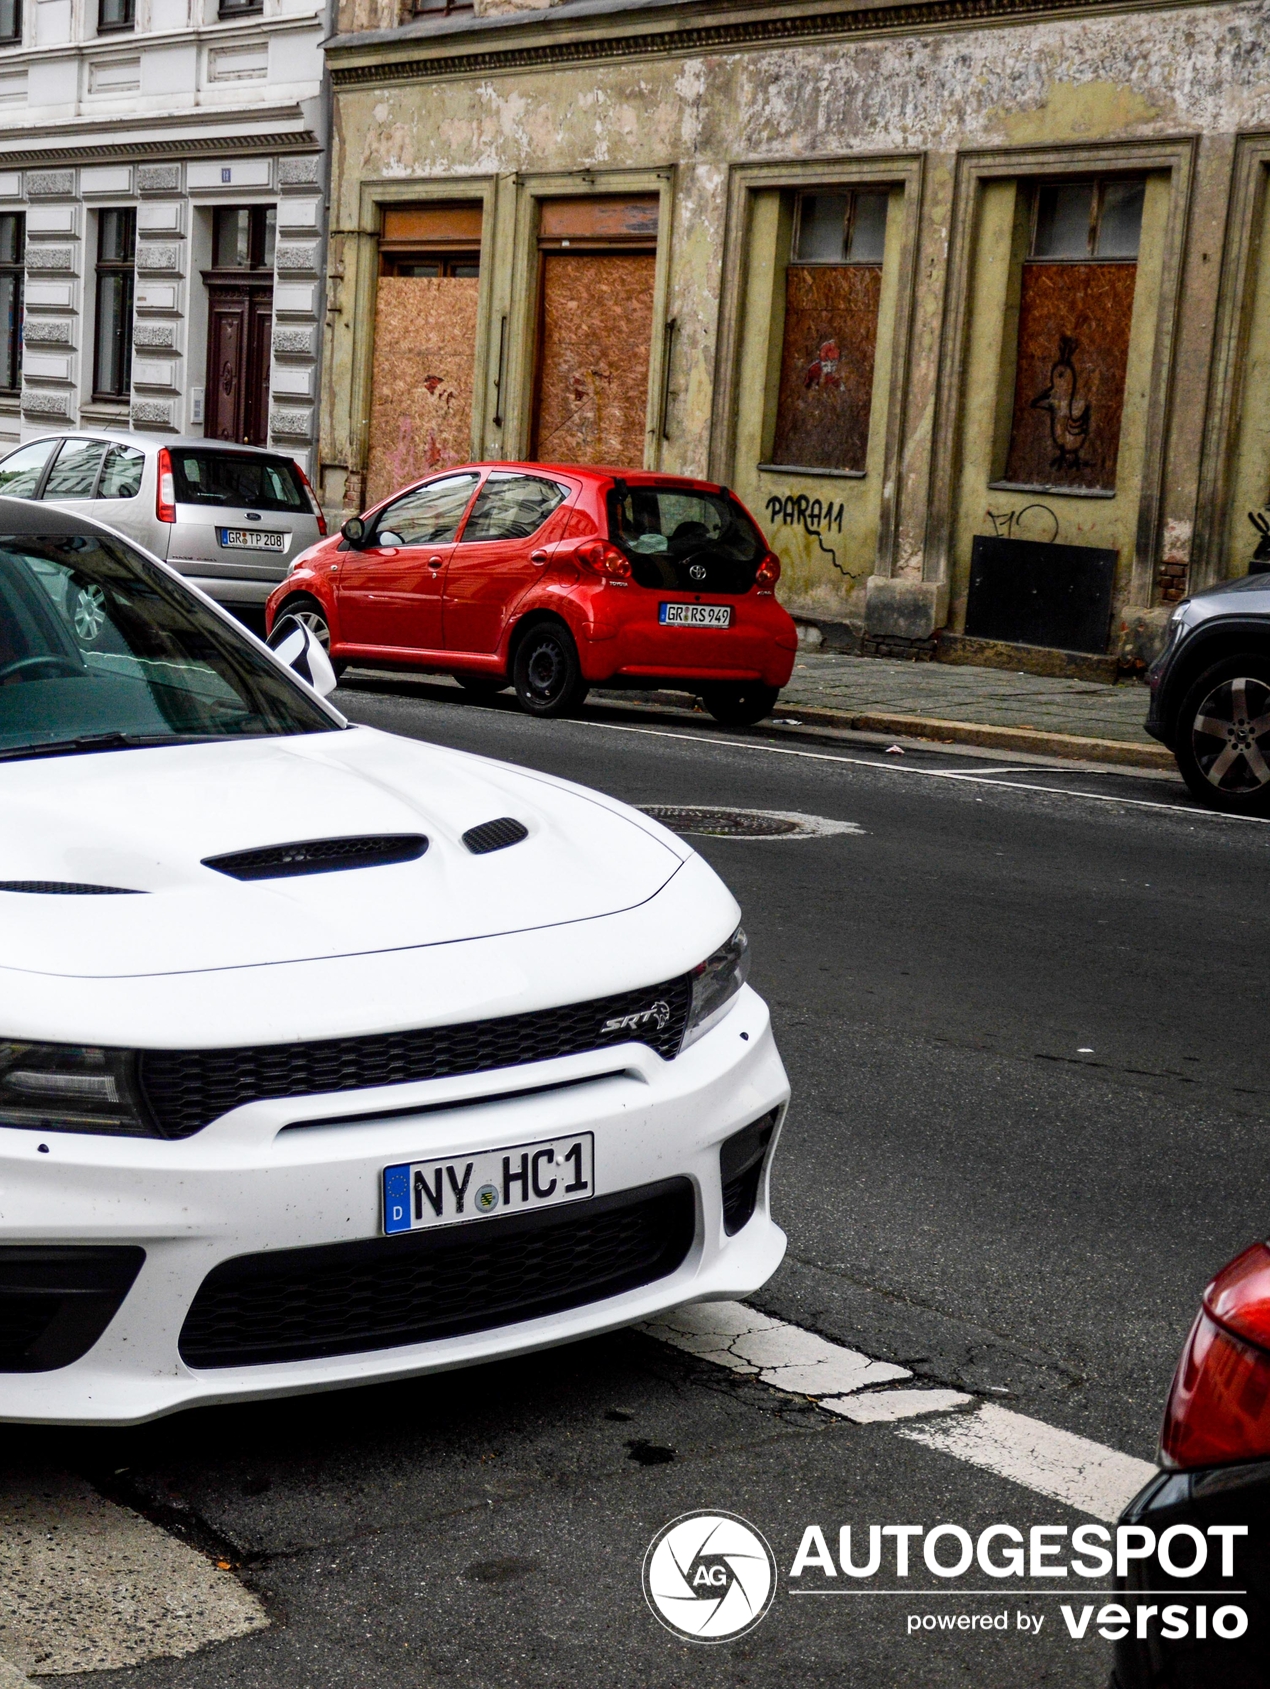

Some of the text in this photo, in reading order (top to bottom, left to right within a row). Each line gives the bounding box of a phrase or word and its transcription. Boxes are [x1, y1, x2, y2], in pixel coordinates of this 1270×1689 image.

[228, 531, 282, 547] GR TP 208
[667, 606, 684, 621] GR
[599, 1009, 657, 1033] SRT
[393, 1206, 403, 1221] D
[414, 1161, 474, 1220] NY
